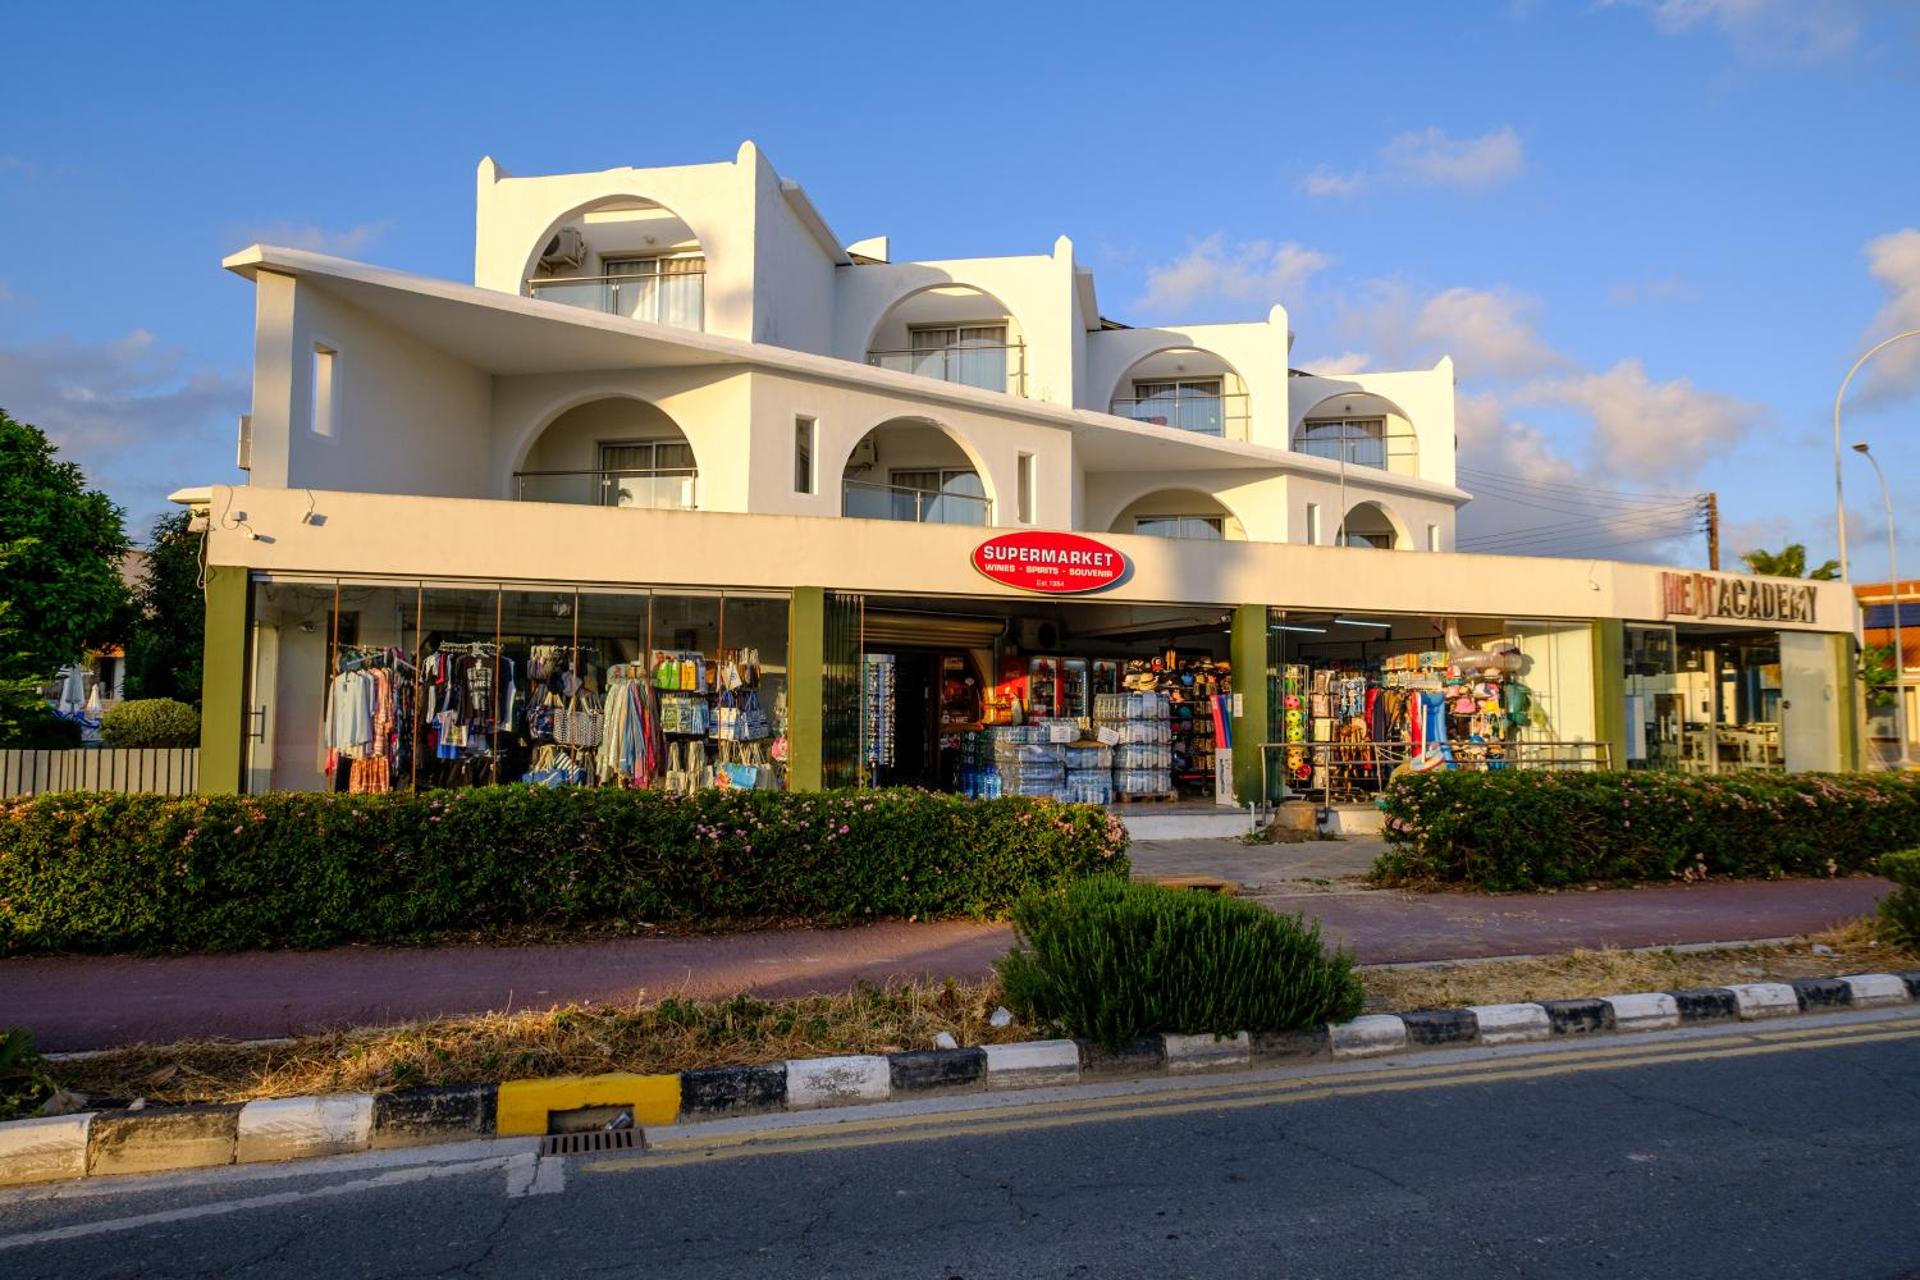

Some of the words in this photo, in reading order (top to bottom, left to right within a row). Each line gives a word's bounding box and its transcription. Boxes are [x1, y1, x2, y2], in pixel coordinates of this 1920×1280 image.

[983, 545, 1113, 567] SUPERMARKET
[985, 563, 1016, 573] WINES
[1025, 565, 1059, 575] SPIRITS
[1069, 567, 1113, 577] SOUVENIR
[1717, 577, 1818, 623] ACADEMY
